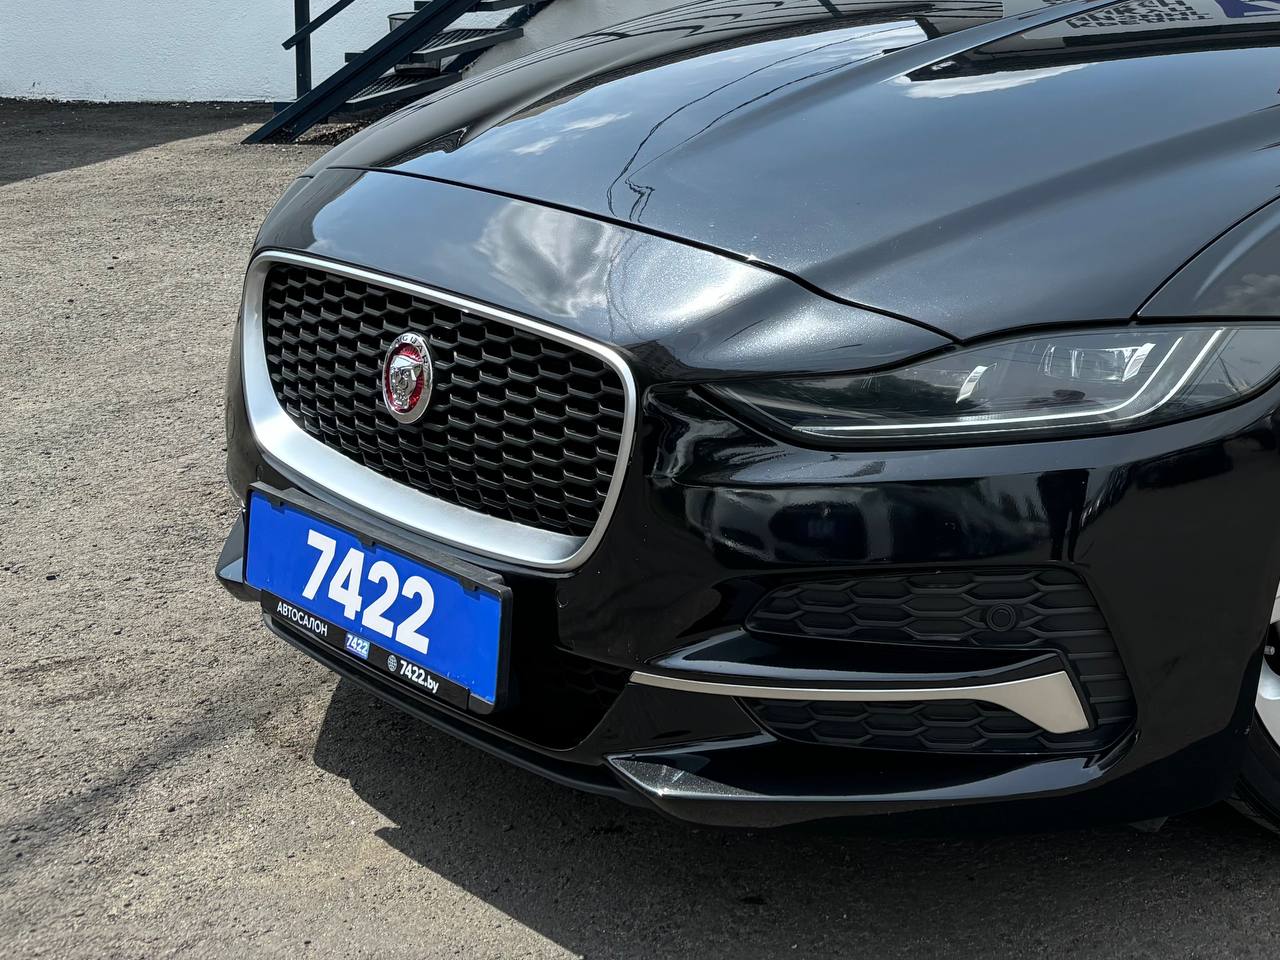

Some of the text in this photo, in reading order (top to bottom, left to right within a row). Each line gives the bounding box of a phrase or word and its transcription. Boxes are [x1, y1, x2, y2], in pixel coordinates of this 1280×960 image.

[301, 529, 435, 655] 7422
[276, 601, 328, 637] АВТОСАЛОН
[346, 634, 369, 655] 7422
[400, 660, 439, 694] 7422.by
